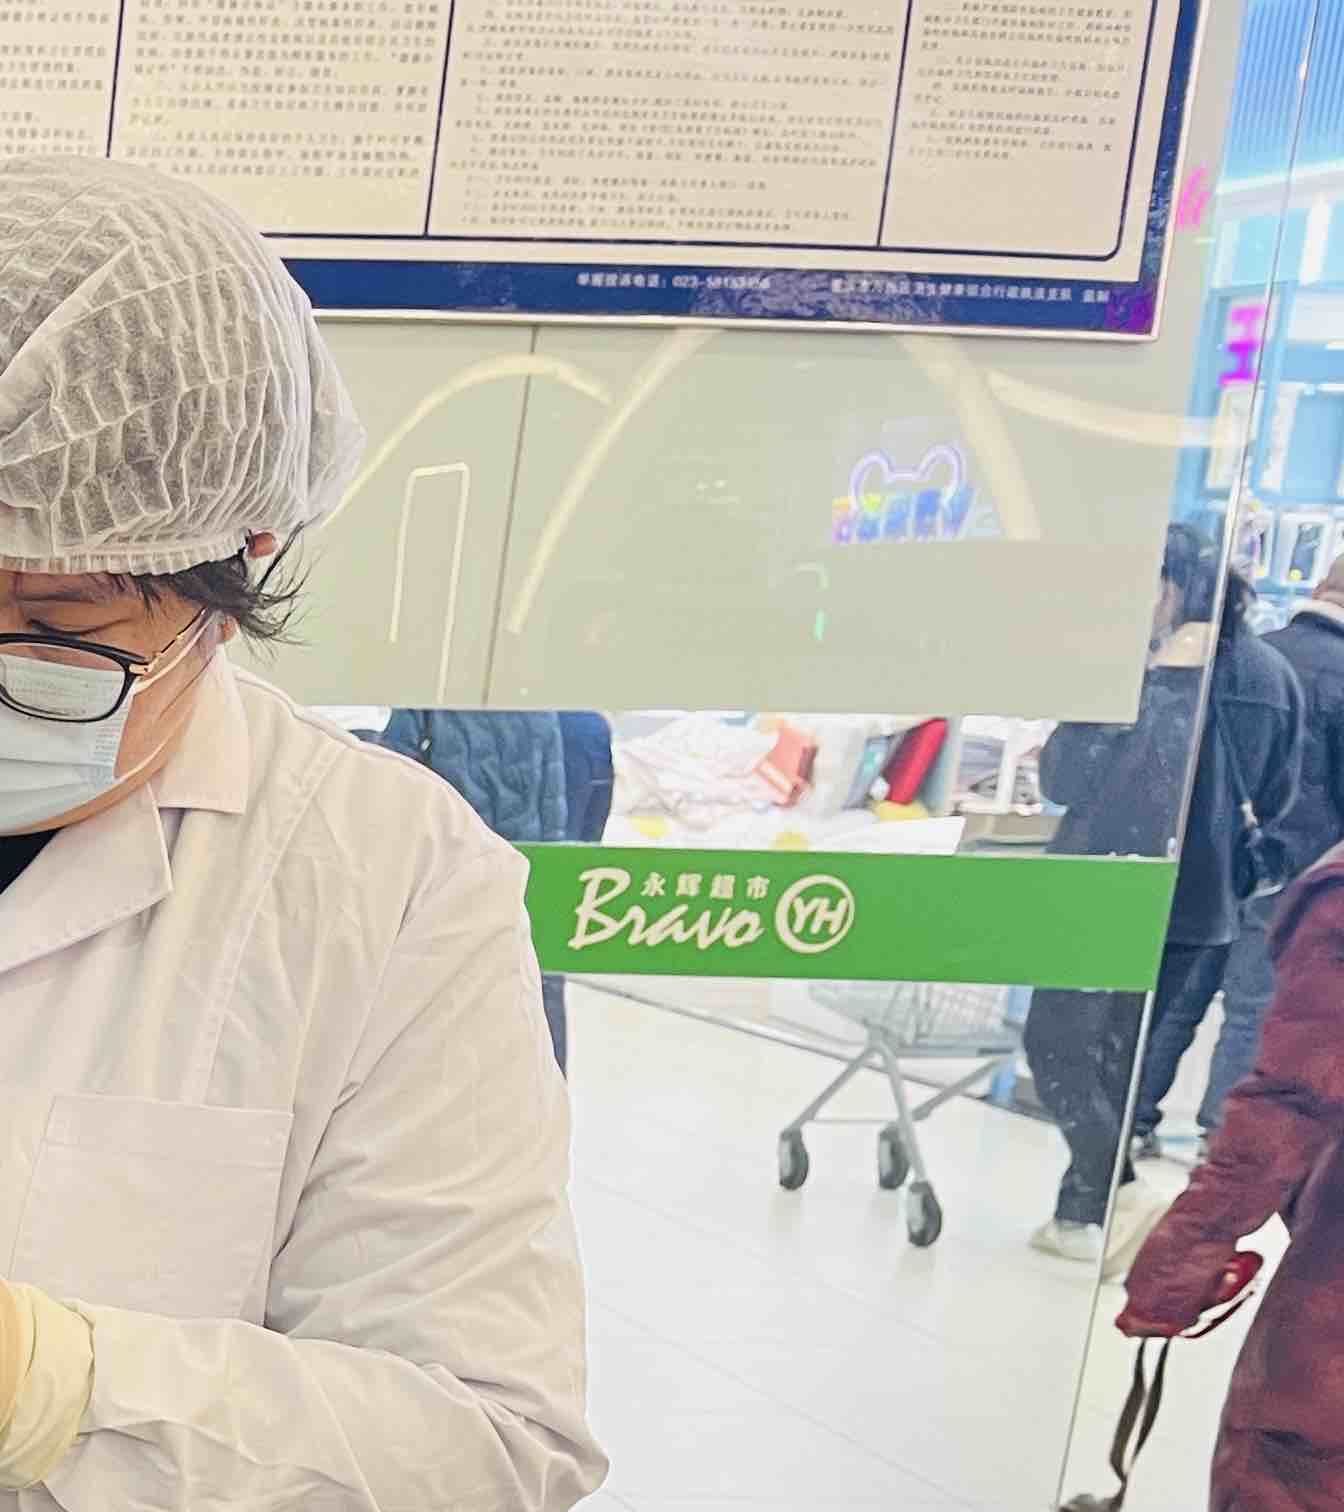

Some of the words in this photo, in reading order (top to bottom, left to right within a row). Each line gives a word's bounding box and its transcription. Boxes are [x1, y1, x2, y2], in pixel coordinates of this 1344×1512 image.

[568, 867, 765, 952] Bravo
[641, 872, 770, 901] 永辉超市
